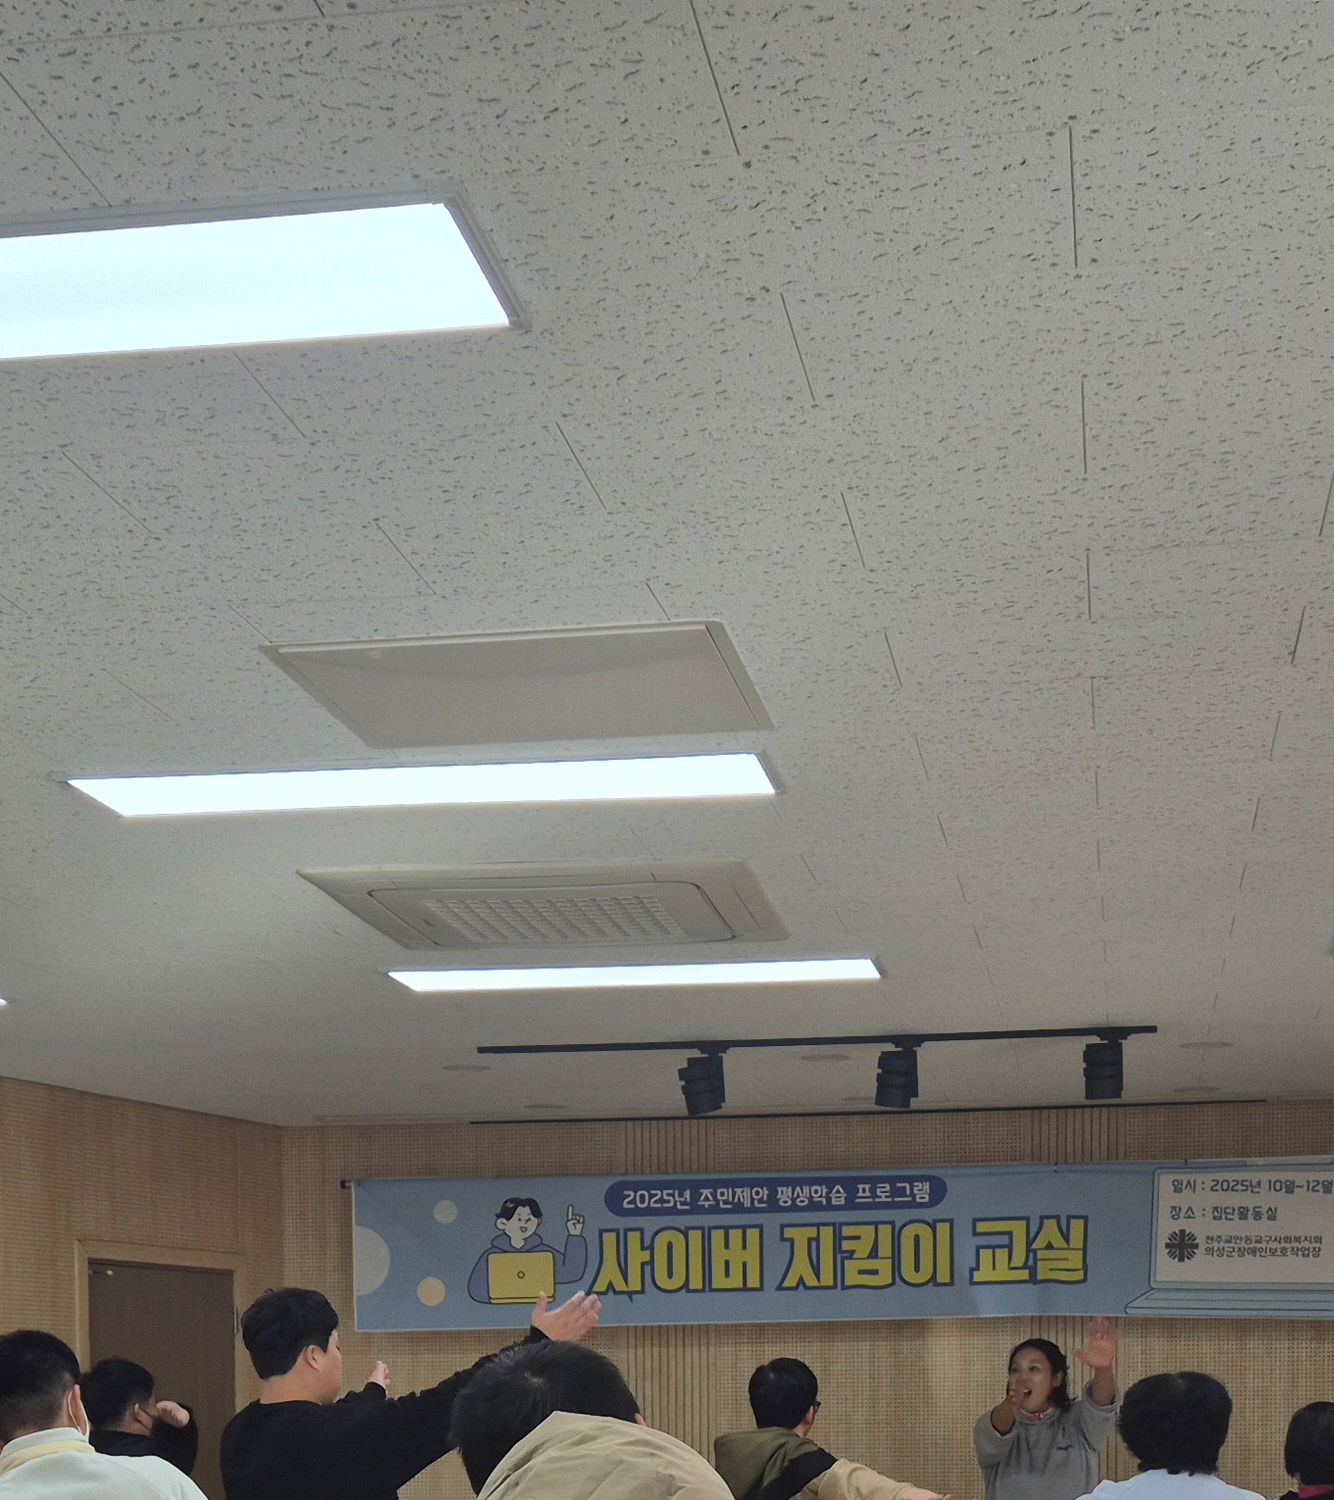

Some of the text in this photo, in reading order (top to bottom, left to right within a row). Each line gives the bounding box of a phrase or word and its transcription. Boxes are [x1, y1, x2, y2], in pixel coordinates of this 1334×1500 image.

[622, 1181, 931, 1210] 2025년 주민제안 평생학습 프로그램
[1171, 1178, 1197, 1194] 일시
[1210, 1178, 1262, 1194] 2025년
[1169, 1205, 1197, 1221] 장소
[1211, 1205, 1278, 1222] 집단활동실
[591, 1215, 1087, 1293] 사이버 지킴이 교실
